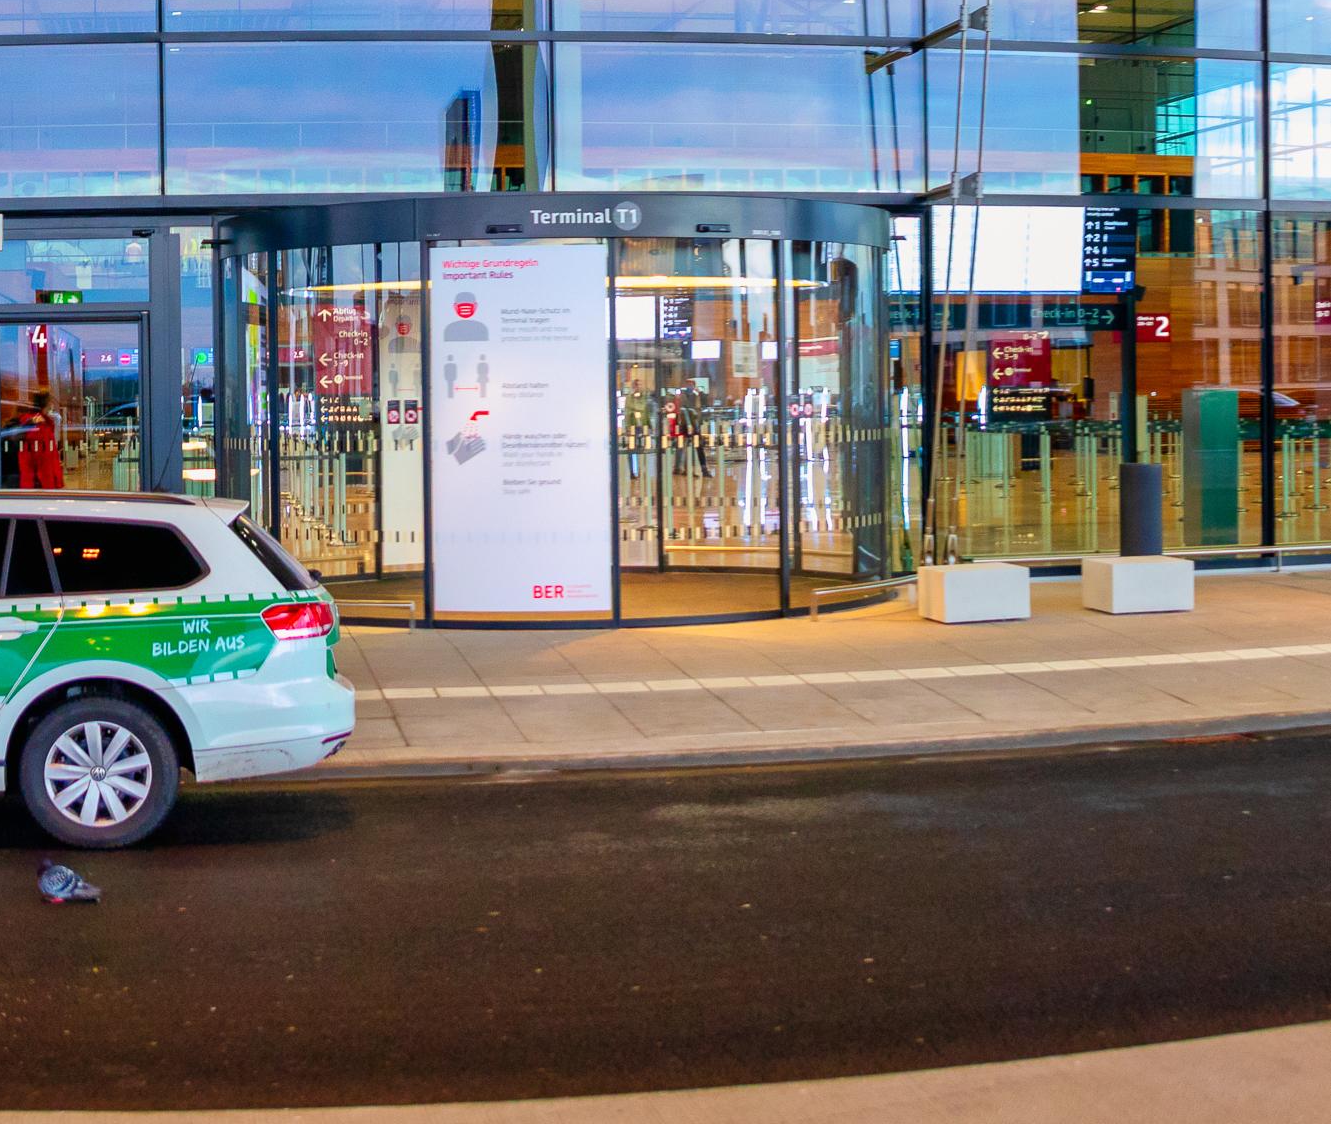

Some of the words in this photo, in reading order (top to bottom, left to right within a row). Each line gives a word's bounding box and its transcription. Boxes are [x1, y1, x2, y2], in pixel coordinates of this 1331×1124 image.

[530, 208, 612, 224] Terminal
[616, 208, 638, 224] T1
[442, 260, 480, 270] Wichtige
[482, 259, 539, 269] Grundregeln
[442, 272, 487, 281] Important
[489, 271, 514, 280] Rules
[1155, 315, 1170, 337] 2
[31, 324, 48, 348] 4
[533, 585, 564, 599] BER
[183, 619, 211, 634] WIR
[152, 638, 210, 657] BILDEN
[215, 635, 245, 653] AUS
